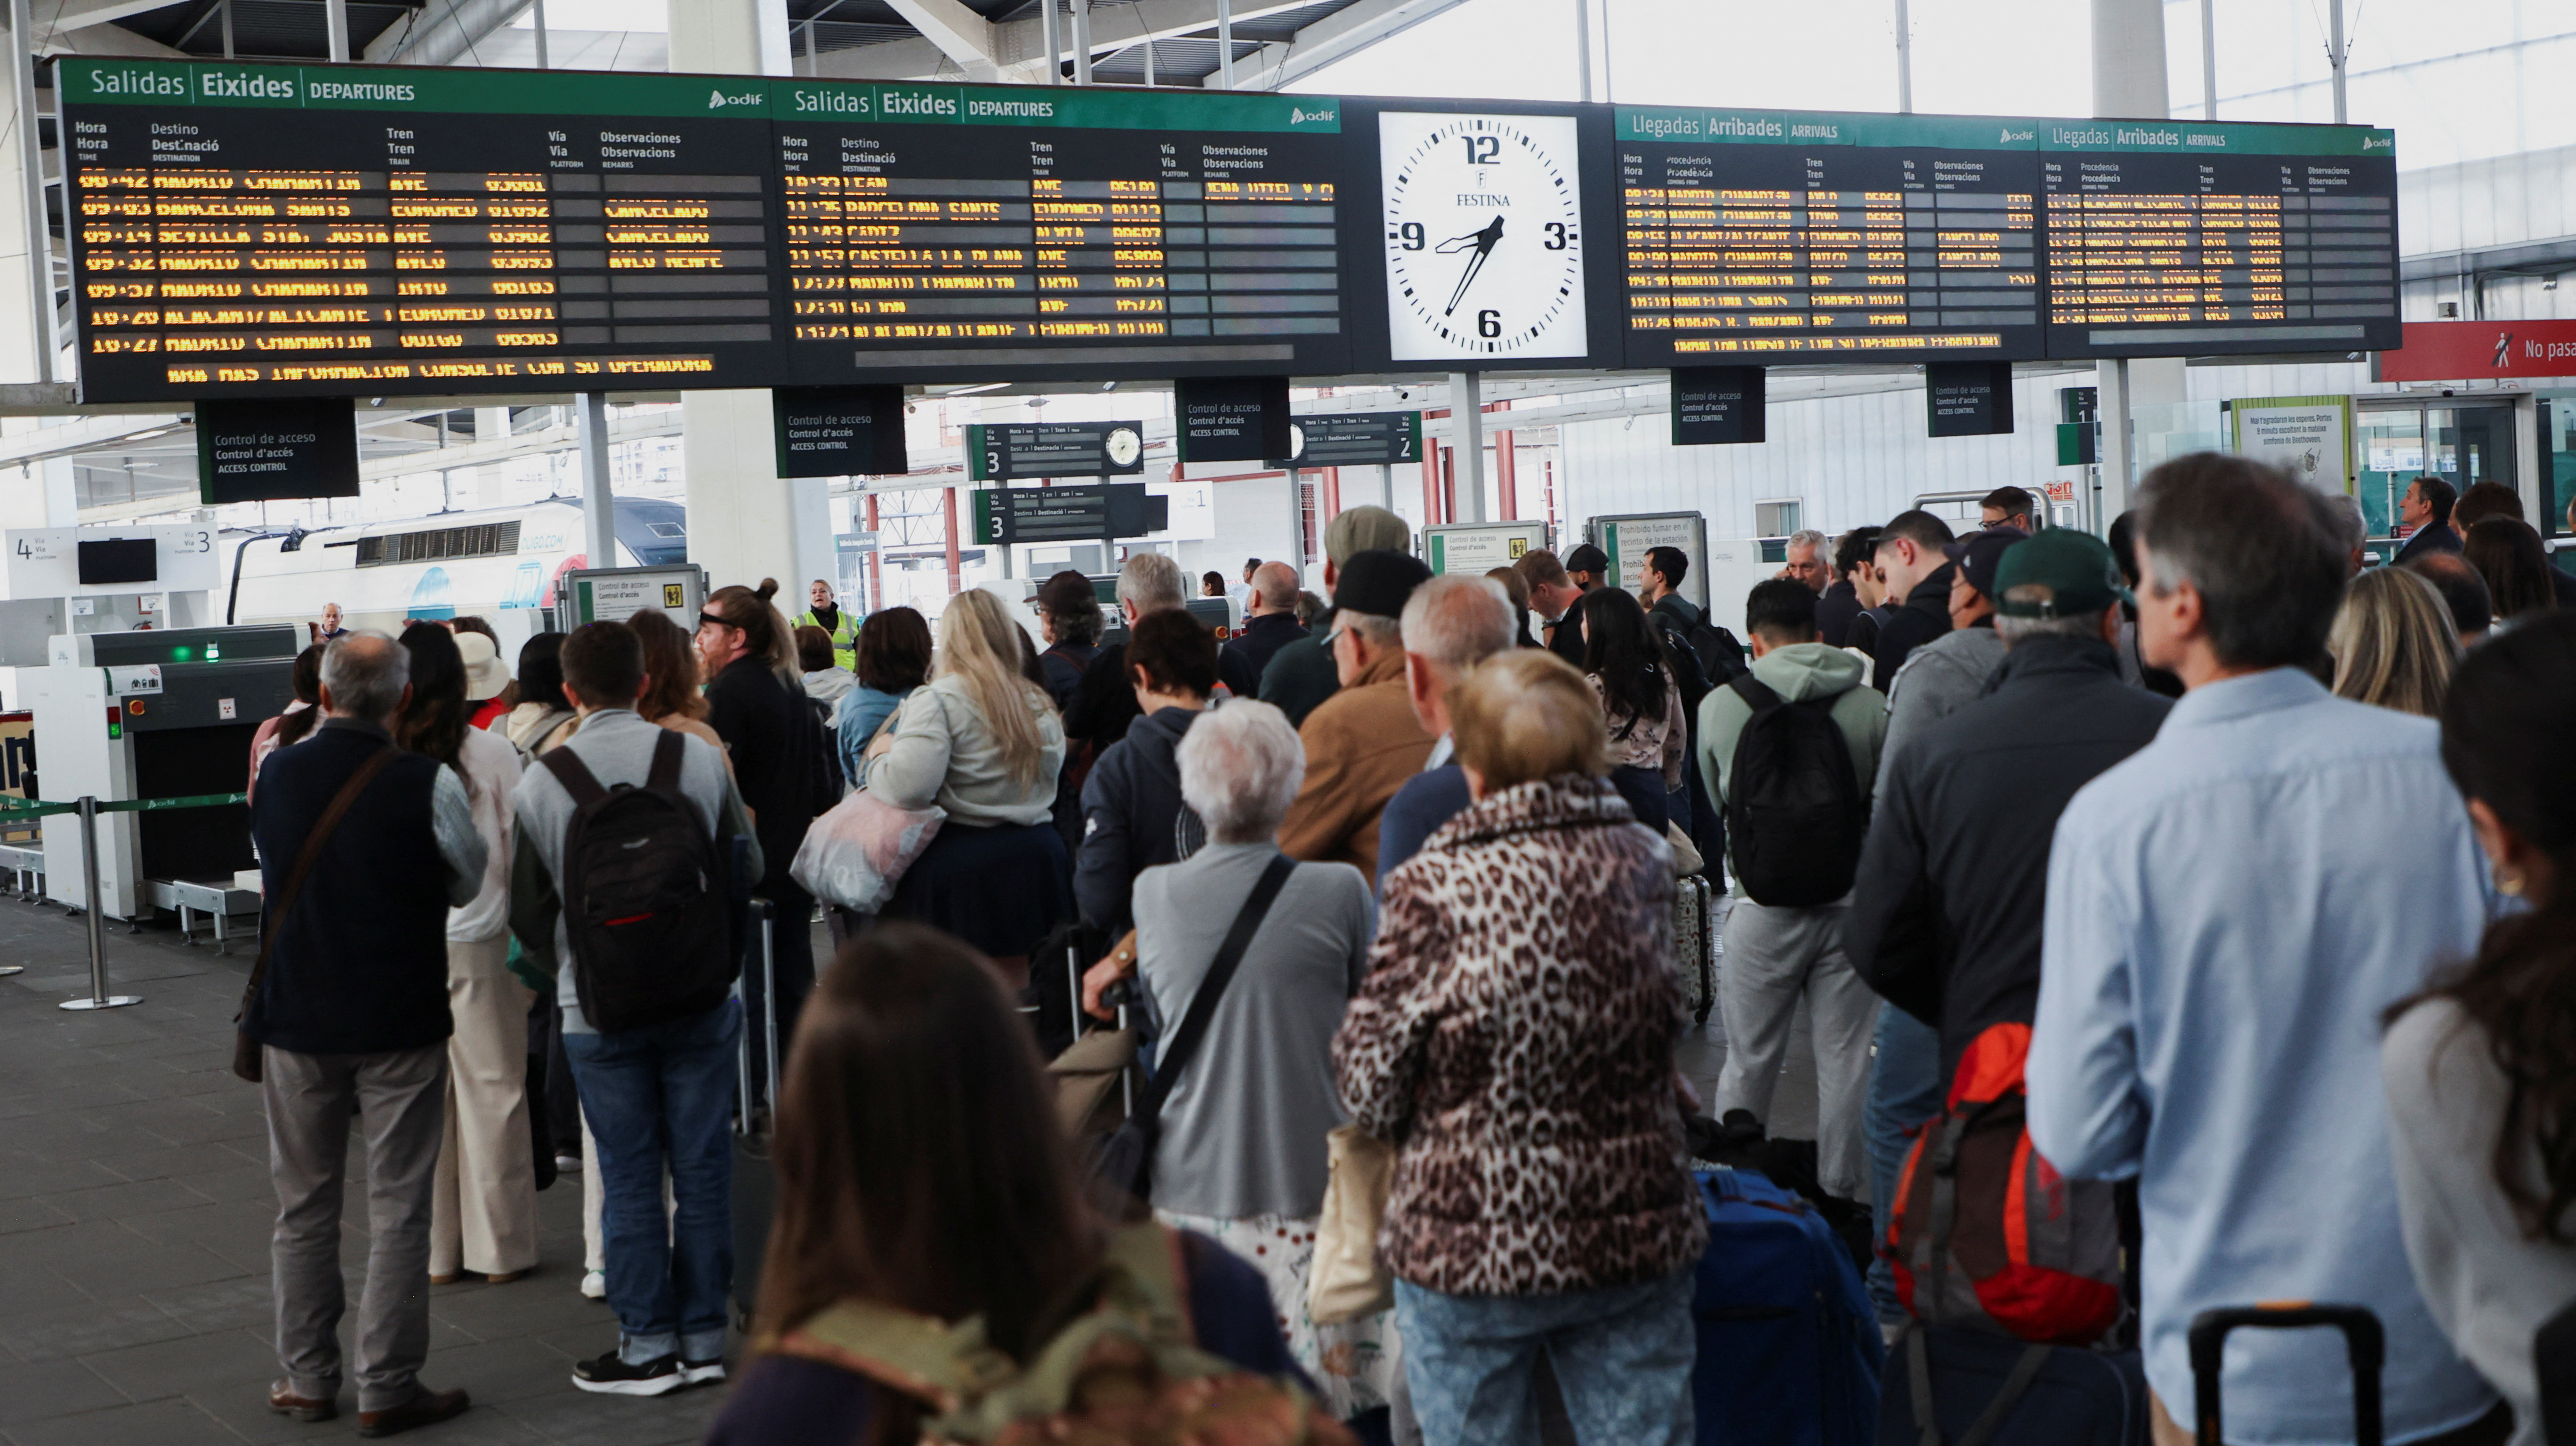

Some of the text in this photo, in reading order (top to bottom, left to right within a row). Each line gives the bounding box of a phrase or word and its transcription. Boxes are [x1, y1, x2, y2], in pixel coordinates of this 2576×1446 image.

[92, 70, 414, 100] Salidas Eixides DEPARTURES
[727, 93, 763, 105] adif
[796, 91, 1053, 116] Salidas Eixides DEPARTURES
[1305, 111, 1335, 121] adif
[76, 122, 106, 133] Hora
[152, 123, 198, 135] Destino
[1634, 115, 1837, 138] Llegadas Arribades ARRIVALS
[387, 128, 413, 139] Tren
[548, 131, 566, 141] Vía
[601, 132, 681, 143] Observaciones
[2012, 131, 2034, 140] adif
[2053, 128, 2225, 147] Llegadas Arribades ARRIVALS
[77, 138, 108, 149] Hora
[783, 136, 807, 146] Hora
[842, 138, 879, 148] Destino
[2373, 139, 2391, 147] adif
[388, 143, 414, 154] Tren
[550, 145, 567, 156] Via
[602, 147, 675, 157] Observacions
[1030, 142, 1052, 152] Tren
[1161, 144, 1175, 154] Vía
[1203, 145, 1268, 155] Observaciones
[1461, 137, 1500, 164] 12
[784, 151, 808, 161] Hora
[842, 153, 895, 163] Destinació
[1031, 155, 1053, 165] Tren
[1624, 154, 1642, 163] Hora
[1667, 156, 1711, 164] Procedencia
[1161, 157, 1175, 167] Via
[1204, 159, 1263, 169] Observacions
[1806, 158, 1822, 167] Tren
[1903, 161, 1914, 169] Vía
[1934, 161, 1983, 170] Observaciones
[2046, 163, 2061, 171] Hora
[2081, 163, 2118, 171] Procedencia
[1625, 167, 1642, 175] Hora
[1807, 170, 1823, 178] Tren
[1904, 172, 1915, 180] Via
[1935, 173, 1980, 181] Observacions
[2082, 174, 2120, 182] Procedència
[1457, 195, 1510, 206] FESTINA
[1401, 223, 1425, 250] 9
[1545, 223, 1566, 250] 3
[1479, 310, 1501, 337] 6
[2526, 340, 2576, 361] No pasa
[1936, 387, 1958, 395] Control
[1682, 393, 1706, 401] Control
[1189, 404, 1217, 413] Control
[1221, 404, 1231, 412] de
[789, 416, 871, 426] Control de acceso
[1189, 416, 1244, 425] Control d'accés
[2079, 410, 2085, 423] 1
[789, 428, 853, 438] Control d'accés
[216, 434, 315, 446] Control de acceso
[1401, 438, 1410, 457] 2
[216, 447, 293, 459] Control d'accés
[988, 452, 999, 473] 3
[218, 463, 287, 473] ACCESS CONTROL
[1197, 490, 1206, 507] 1
[991, 517, 1003, 538] 3
[1620, 525, 1650, 534] Prohibido
[198, 532, 209, 552] 3
[521, 535, 563, 549] OUIGO.COM
[1662, 534, 1688, 543] estación
[17, 539, 32, 559] 4
